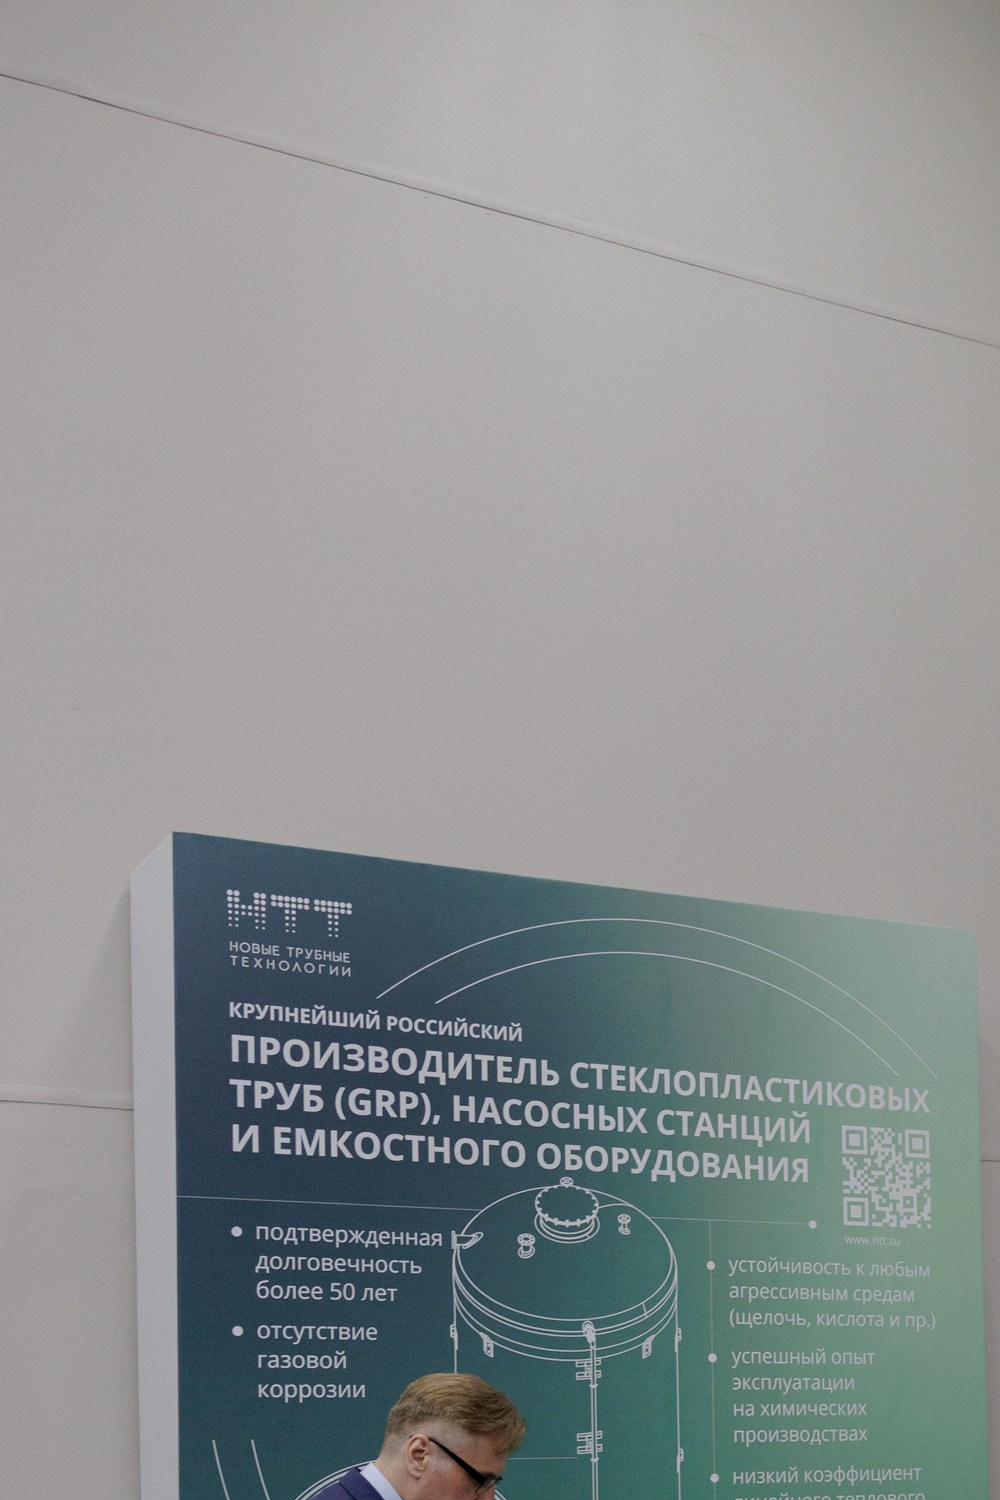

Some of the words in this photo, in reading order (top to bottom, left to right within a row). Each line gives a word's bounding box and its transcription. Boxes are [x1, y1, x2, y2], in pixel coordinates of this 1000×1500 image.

[226, 889, 352, 937] НТТ
[229, 941, 280, 956] НОВЫЕ
[286, 946, 351, 963] ТРУБНЫЕ
[230, 955, 351, 977] ТЕХНОЛОГИИ
[230, 1002, 380, 1029] КРУПНЕЙШИЙ
[387, 1016, 522, 1041] РОССИЙСКИЙ
[230, 1034, 559, 1087] ПРОИЗВОДИТЕЛЬ
[569, 1062, 931, 1114] СТЕКЛОПЛАСТИКОВЫХ
[229, 1079, 323, 1112] ТРУБ
[335, 1086, 441, 1126] (GRP),
[453, 1095, 647, 1133] НАСОСНЫХ
[656, 1109, 811, 1148] СТАНЦИЙ
[233, 1124, 259, 1152] И
[273, 1126, 526, 1167] ЕМКОСТНОГО
[537, 1142, 810, 1183] ОБОРУДОВАНИЯ
[256, 1226, 442, 1248] подтвержденная
[844, 1236, 901, 1246] www.ntt.su
[255, 1256, 422, 1273] долговечность
[728, 1257, 850, 1276] устойчивость
[857, 1264, 864, 1275] к
[870, 1261, 931, 1277] любым
[256, 1280, 323, 1300] более
[331, 1283, 355, 1300] 50
[361, 1288, 397, 1301] лет
[729, 1285, 848, 1303] агрессивным
[854, 1289, 914, 1305] средам
[729, 1309, 810, 1329] (щелочь,
[817, 1314, 884, 1326] кислота
[890, 1316, 899, 1327] и
[906, 1313, 935, 1331] пр.)
[257, 1325, 377, 1344] отсутствие
[258, 1351, 346, 1369] газовой
[731, 1348, 825, 1368] успешный
[831, 1351, 875, 1365] опыт
[258, 1384, 365, 1403] коррозии
[732, 1377, 854, 1395] эксплуатации
[734, 1404, 754, 1416] на
[761, 1404, 866, 1416] химических
[734, 1429, 867, 1447] производствах
[733, 1467, 798, 1484] низкий
[804, 1465, 921, 1486] коэффициент
